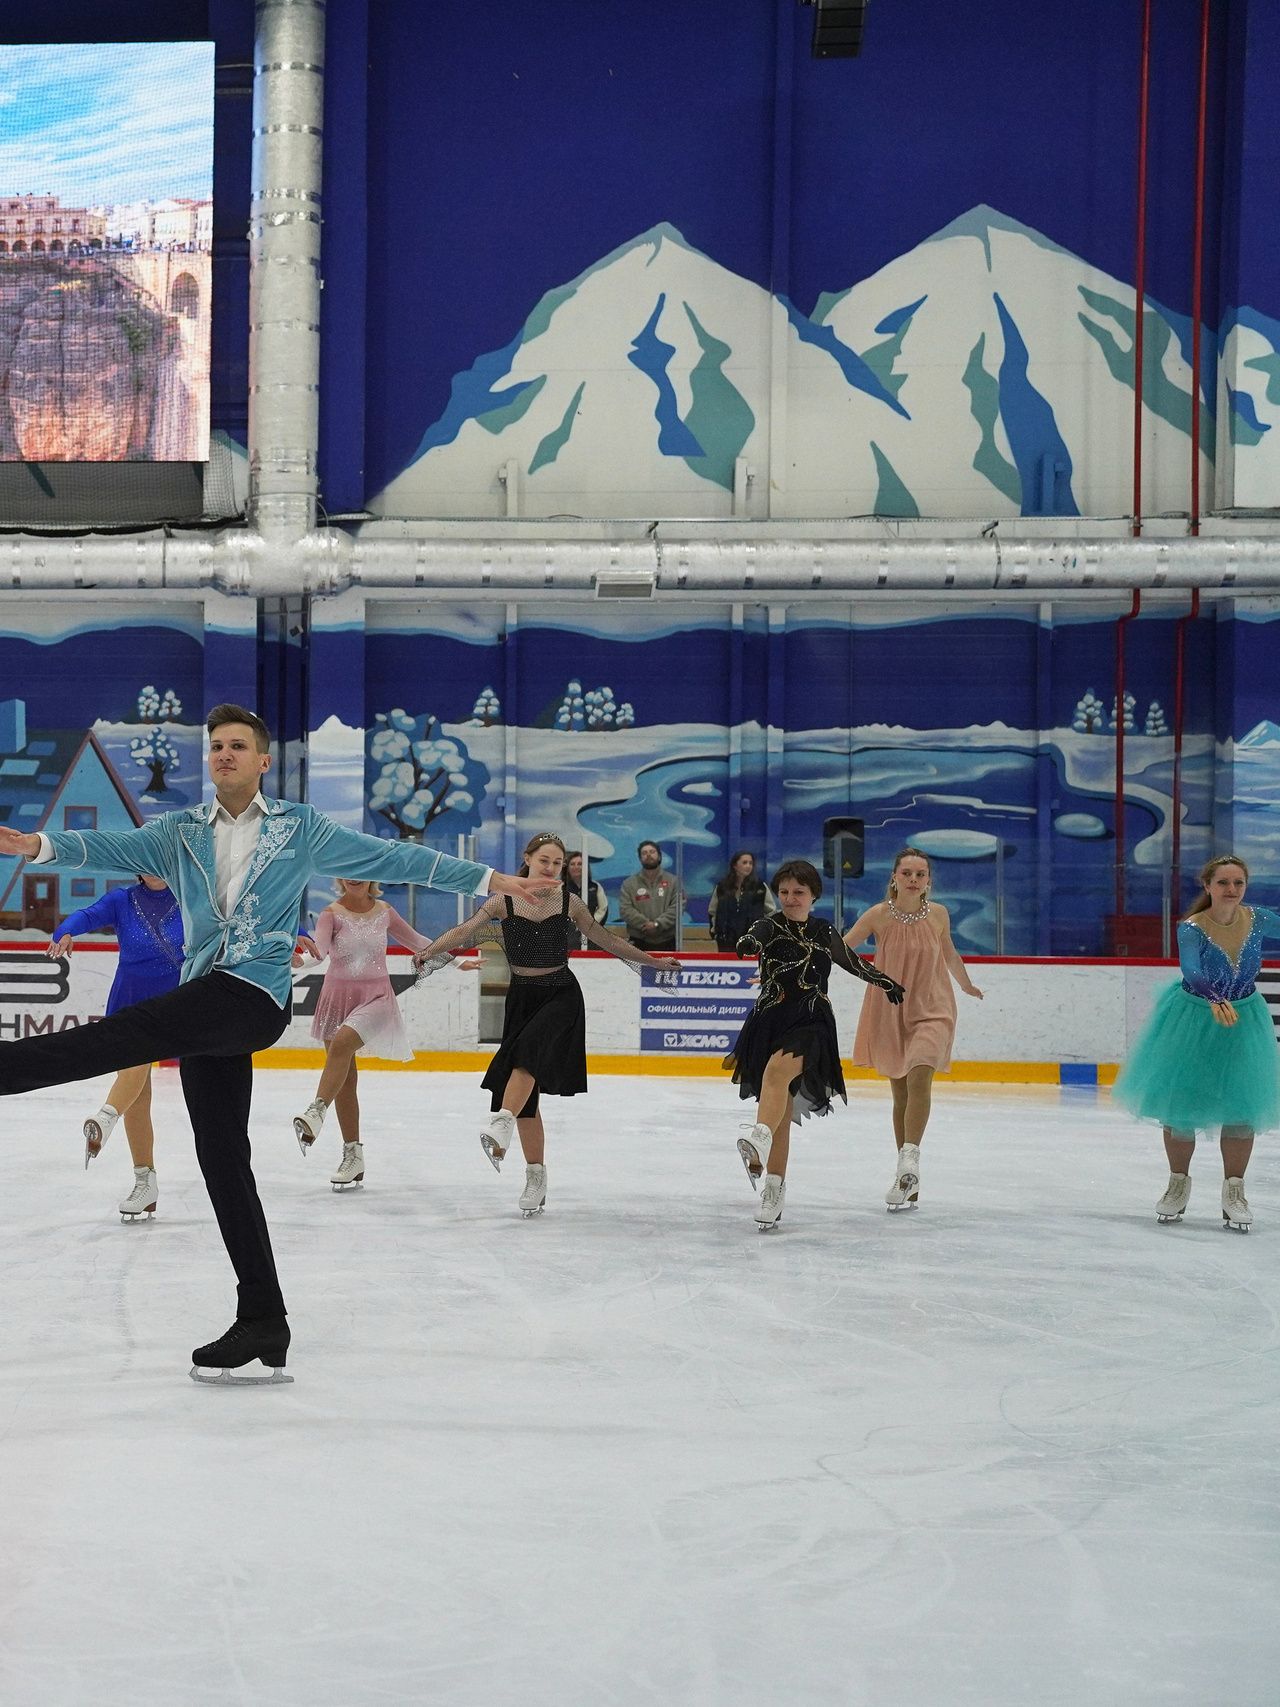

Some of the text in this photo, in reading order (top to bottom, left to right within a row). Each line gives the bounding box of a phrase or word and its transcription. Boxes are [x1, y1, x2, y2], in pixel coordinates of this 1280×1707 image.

[681, 971, 741, 985] ТЕХНО
[647, 1004, 747, 1015] ОФИЦИАЛЬНЫЙ ДИЛЕР
[677, 1034, 730, 1048] XCMG
